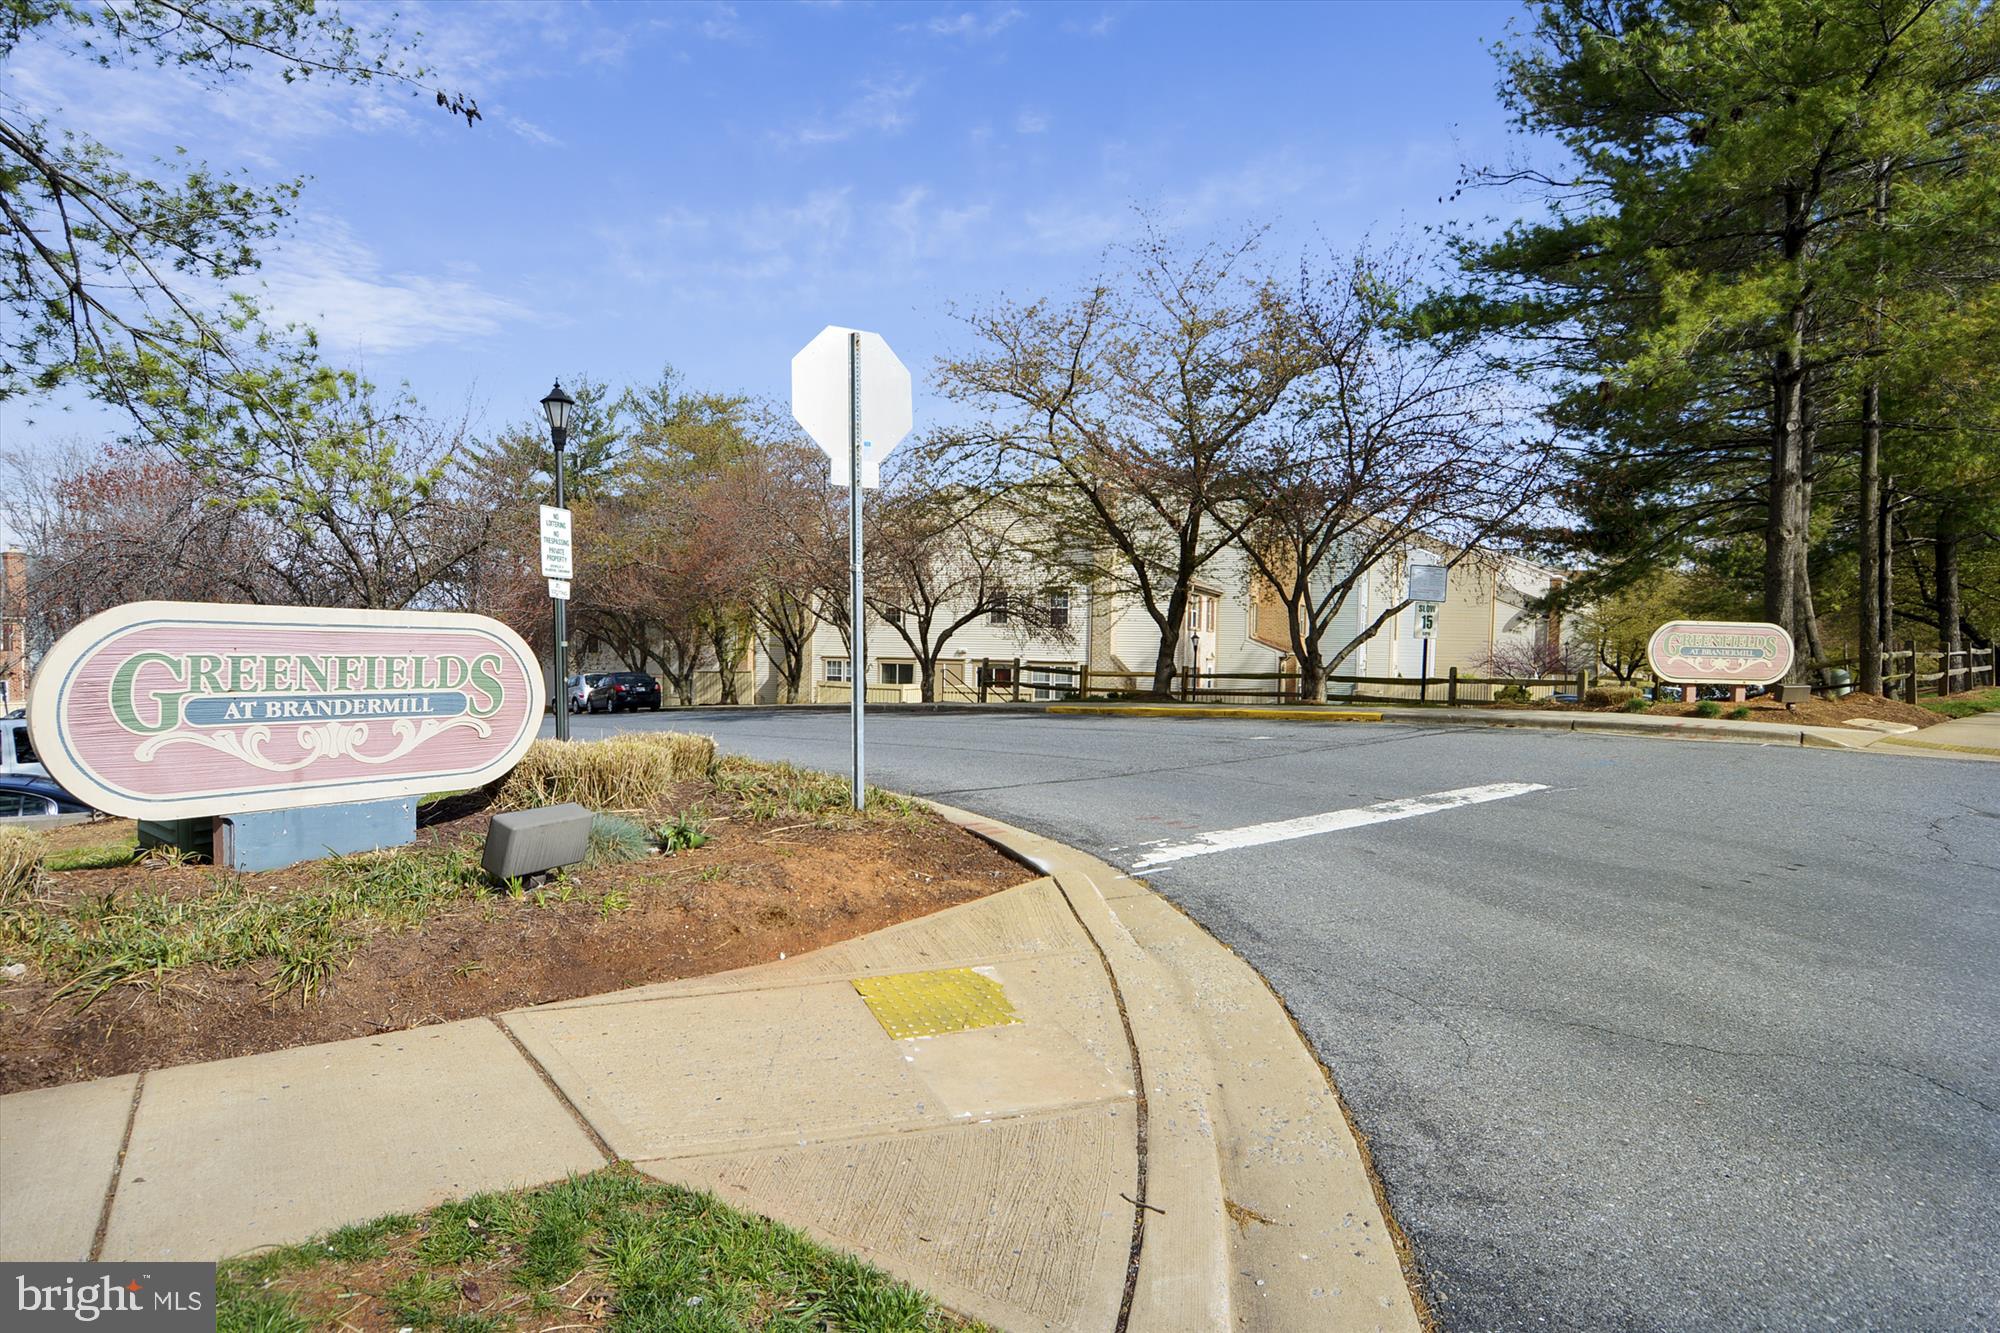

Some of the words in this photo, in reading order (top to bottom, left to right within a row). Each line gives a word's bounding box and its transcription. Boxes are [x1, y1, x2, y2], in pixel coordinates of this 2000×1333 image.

[546, 520, 566, 529] LOITERING
[544, 537, 570, 547] TRESPASSING
[549, 547, 565, 556] PRIVATE
[547, 555, 567, 563] PROPERTY
[1419, 605, 1435, 613] SLOW
[1422, 615, 1433, 629] 15
[1663, 632, 1777, 659] GREENFIELDS
[1702, 649, 1755, 657] BRANDERMILL
[110, 651, 503, 735] GREENFIELDS
[223, 701, 258, 721] AT
[265, 696, 435, 719] BRANDERMILL
